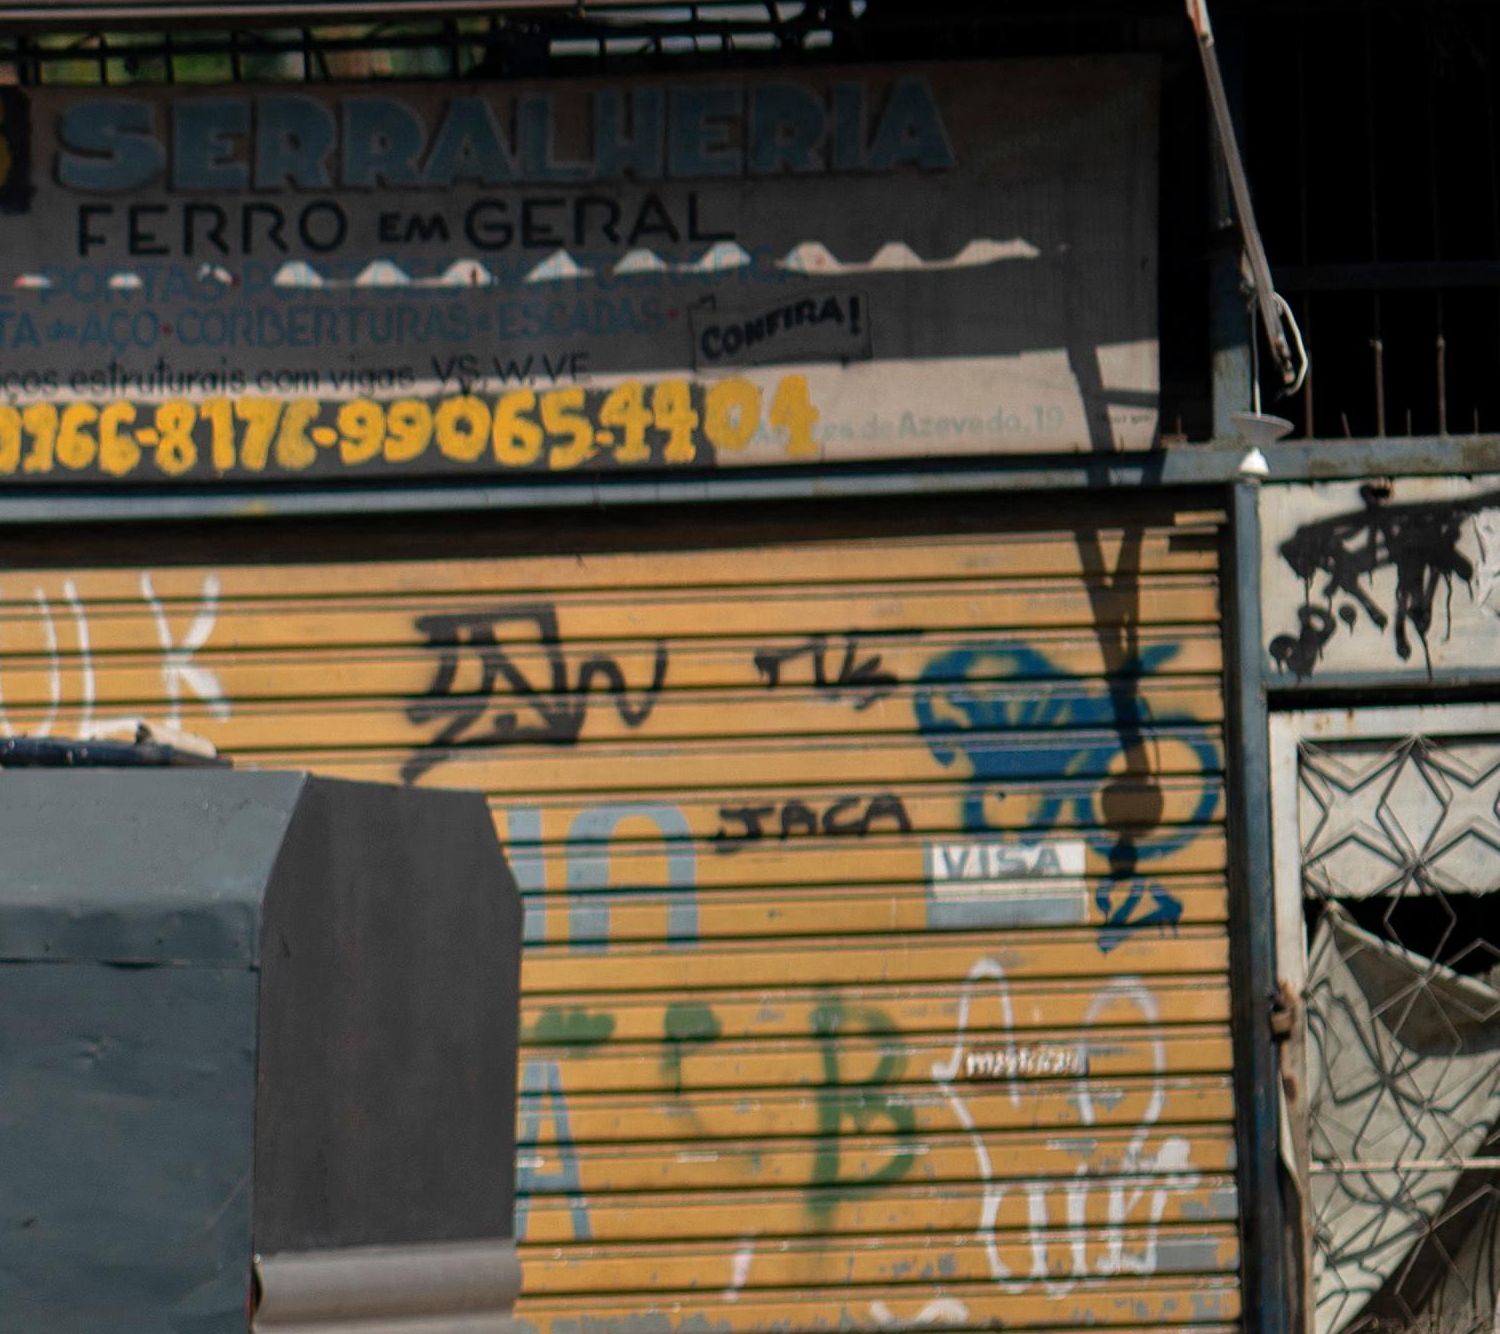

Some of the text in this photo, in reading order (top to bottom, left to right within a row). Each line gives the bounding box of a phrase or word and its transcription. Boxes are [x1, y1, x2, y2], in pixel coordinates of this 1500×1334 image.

[55, 77, 957, 192] SERRALHERIA
[78, 201, 349, 257] FERRO
[464, 192, 740, 250] GERAL
[78, 307, 161, 354] AÇO
[498, 296, 666, 341] ESCADAS
[700, 294, 862, 362] CONFIRA!
[70, 355, 246, 396] estruturais
[256, 371, 319, 394] com
[328, 355, 414, 398] vigas
[940, 843, 1062, 878] VISA
